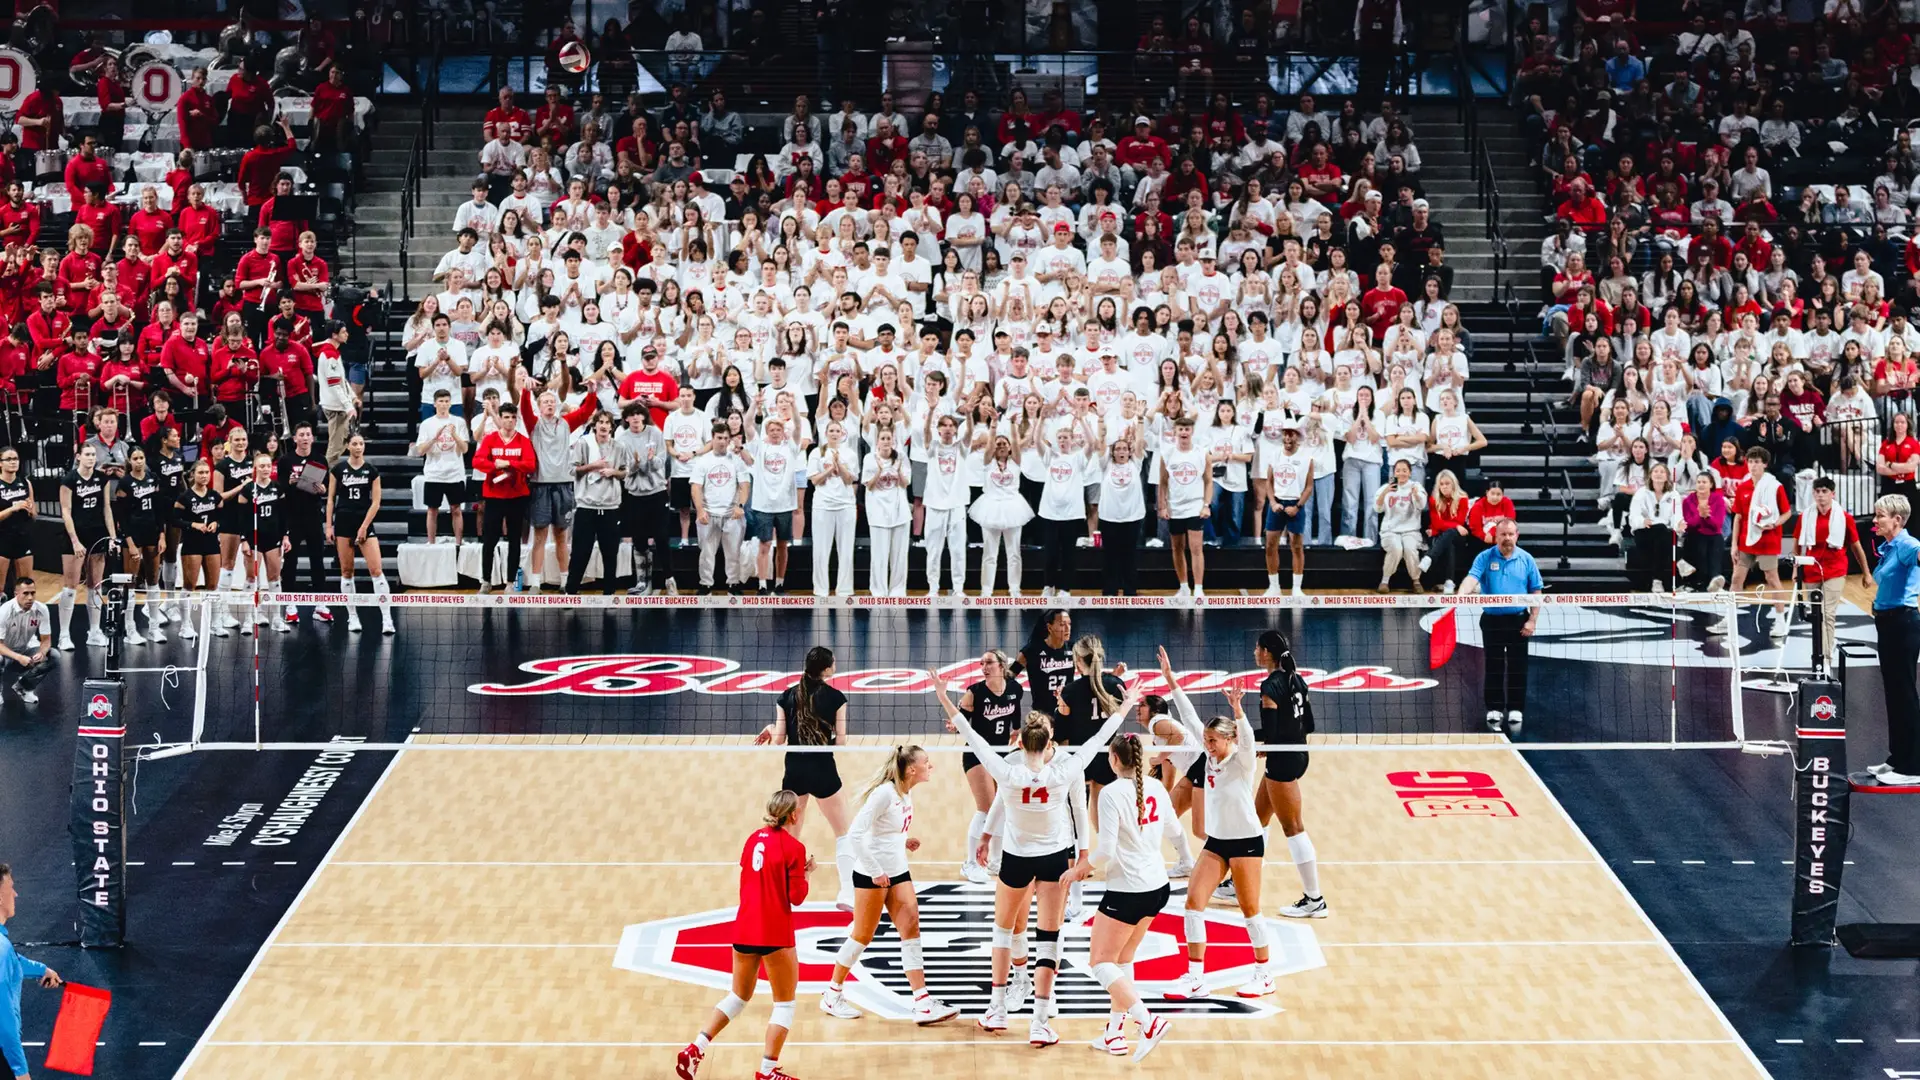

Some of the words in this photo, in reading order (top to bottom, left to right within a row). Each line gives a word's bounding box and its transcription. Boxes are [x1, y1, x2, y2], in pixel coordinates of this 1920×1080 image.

[144, 68, 170, 104] O
[349, 488, 361, 500] 13
[83, 497, 97, 509] 22
[142, 498, 152, 510] 21
[260, 505, 271, 517] 10
[509, 596, 525, 604] OHIO
[527, 596, 547, 604] STATE
[548, 596, 581, 604] BUCKEYES
[626, 597, 642, 605] OHIO
[644, 597, 664, 605] STATE
[665, 597, 698, 605] BUCKEYES
[1440, 596, 1457, 604] OHIO
[1458, 596, 1478, 604] STATE
[1480, 596, 1512, 604] BUCKEYES
[1048, 676, 1067, 691] 27
[995, 721, 1004, 734] 6
[92, 744, 109, 812] OHIO
[1022, 786, 1049, 804] 14
[250, 765, 344, 846] O'SHAUGHNESSY
[1808, 757, 1830, 894] BUCKEYES
[203, 829, 242, 846] Mike
[92, 821, 110, 906] STATE
[752, 842, 766, 872] 6
